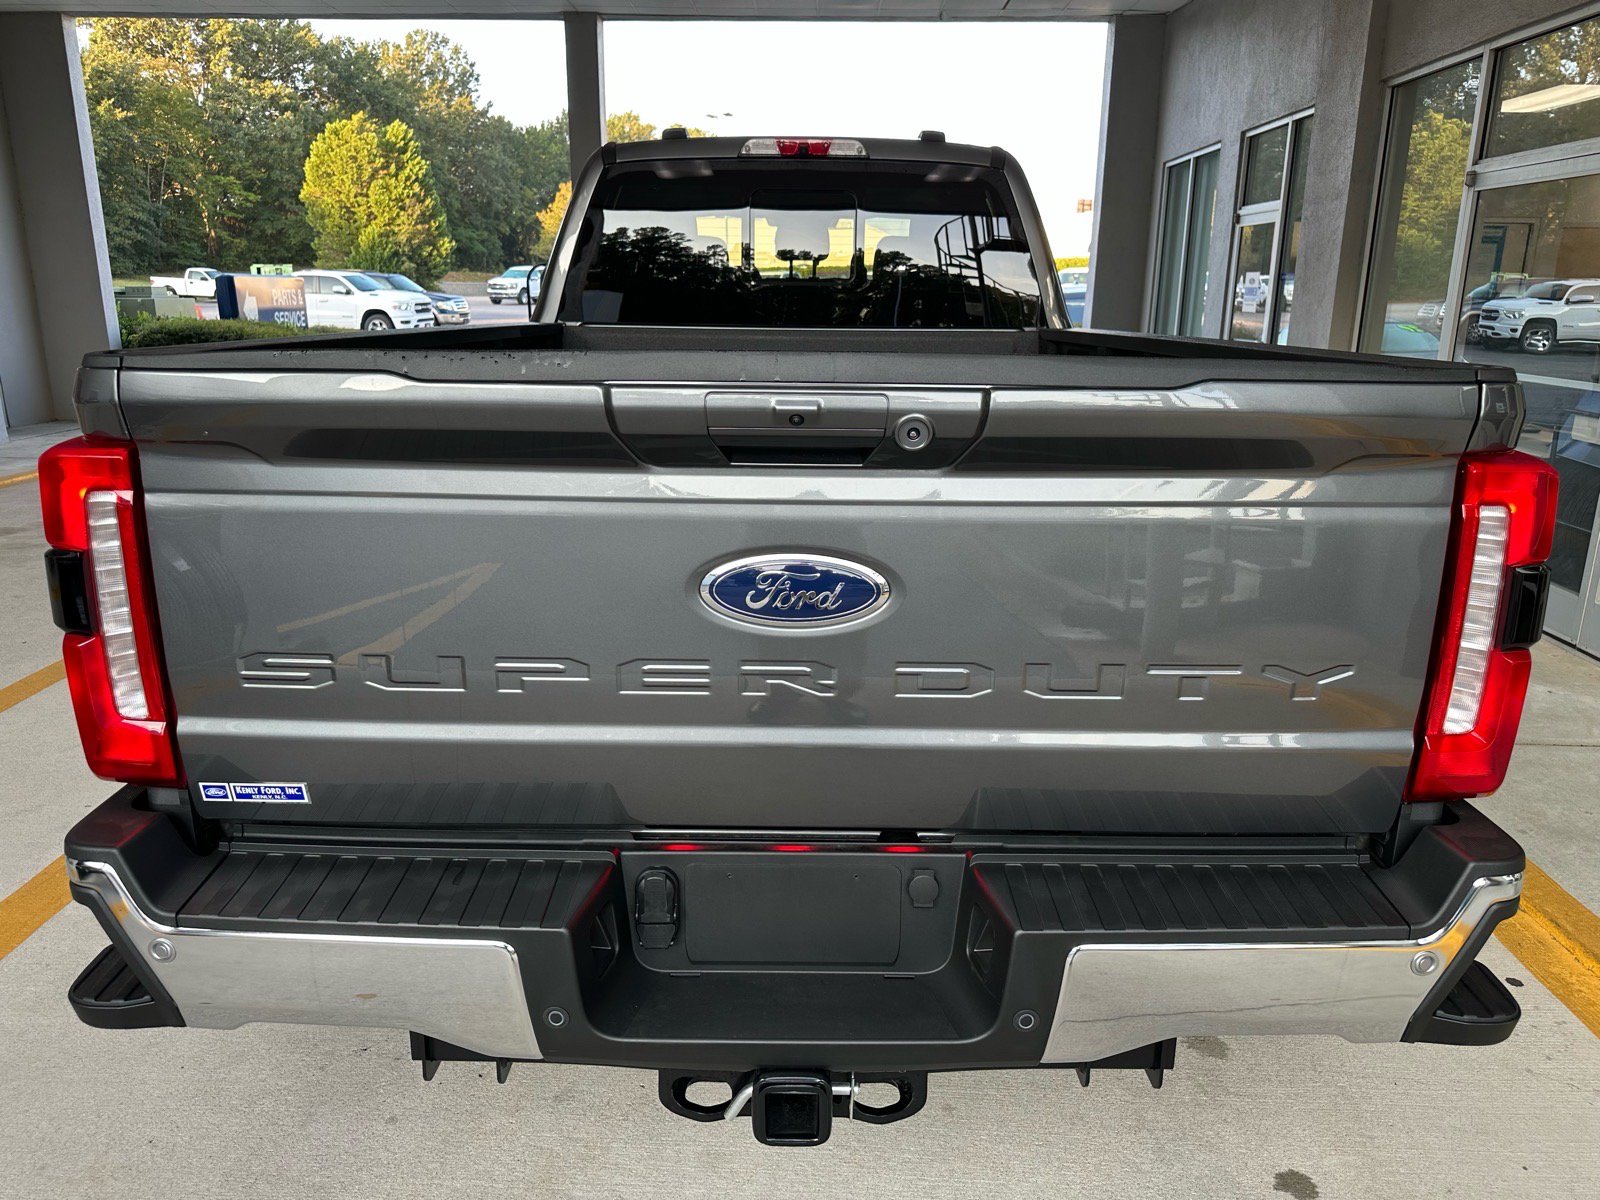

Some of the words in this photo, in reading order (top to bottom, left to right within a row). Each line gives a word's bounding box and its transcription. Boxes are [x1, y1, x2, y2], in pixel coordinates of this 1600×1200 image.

[272, 288, 297, 305] PARTS
[297, 289, 304, 305] &
[274, 311, 306, 327] SERVICE
[744, 570, 846, 610] Ford
[236, 651, 838, 697] SUPER
[894, 661, 1356, 702] DUTY
